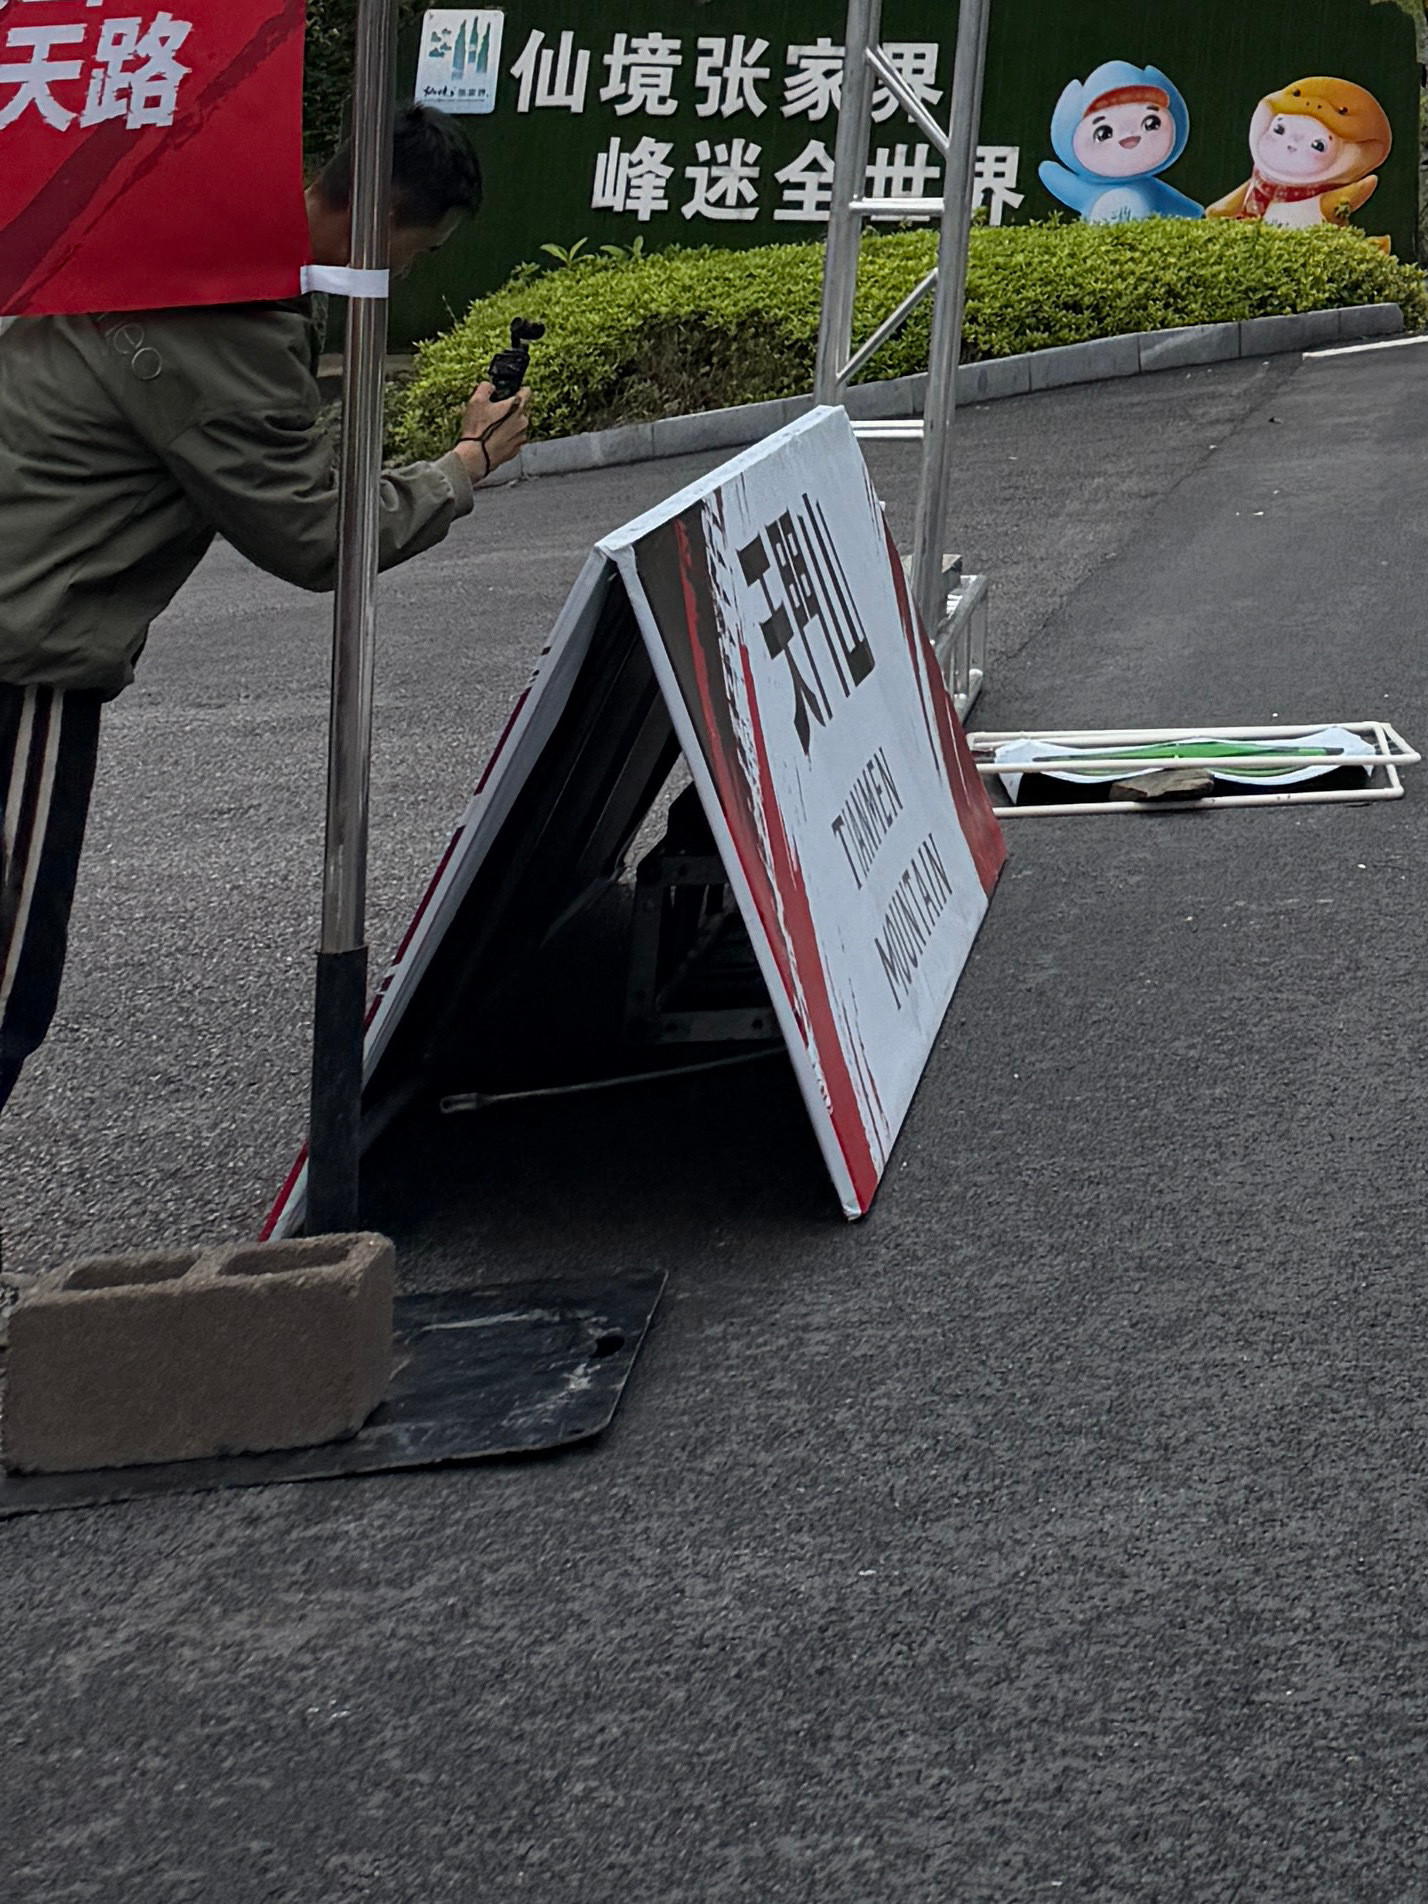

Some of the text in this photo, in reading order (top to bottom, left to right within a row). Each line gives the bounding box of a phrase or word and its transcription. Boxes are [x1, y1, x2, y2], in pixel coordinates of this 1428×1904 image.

[509, 28, 945, 124] 仙境张家界
[590, 135, 1025, 227] 峰迷全世界
[736, 492, 876, 757] 天門山
[831, 746, 904, 891] TIANMEN
[874, 832, 953, 1011] MOUNTAIN
